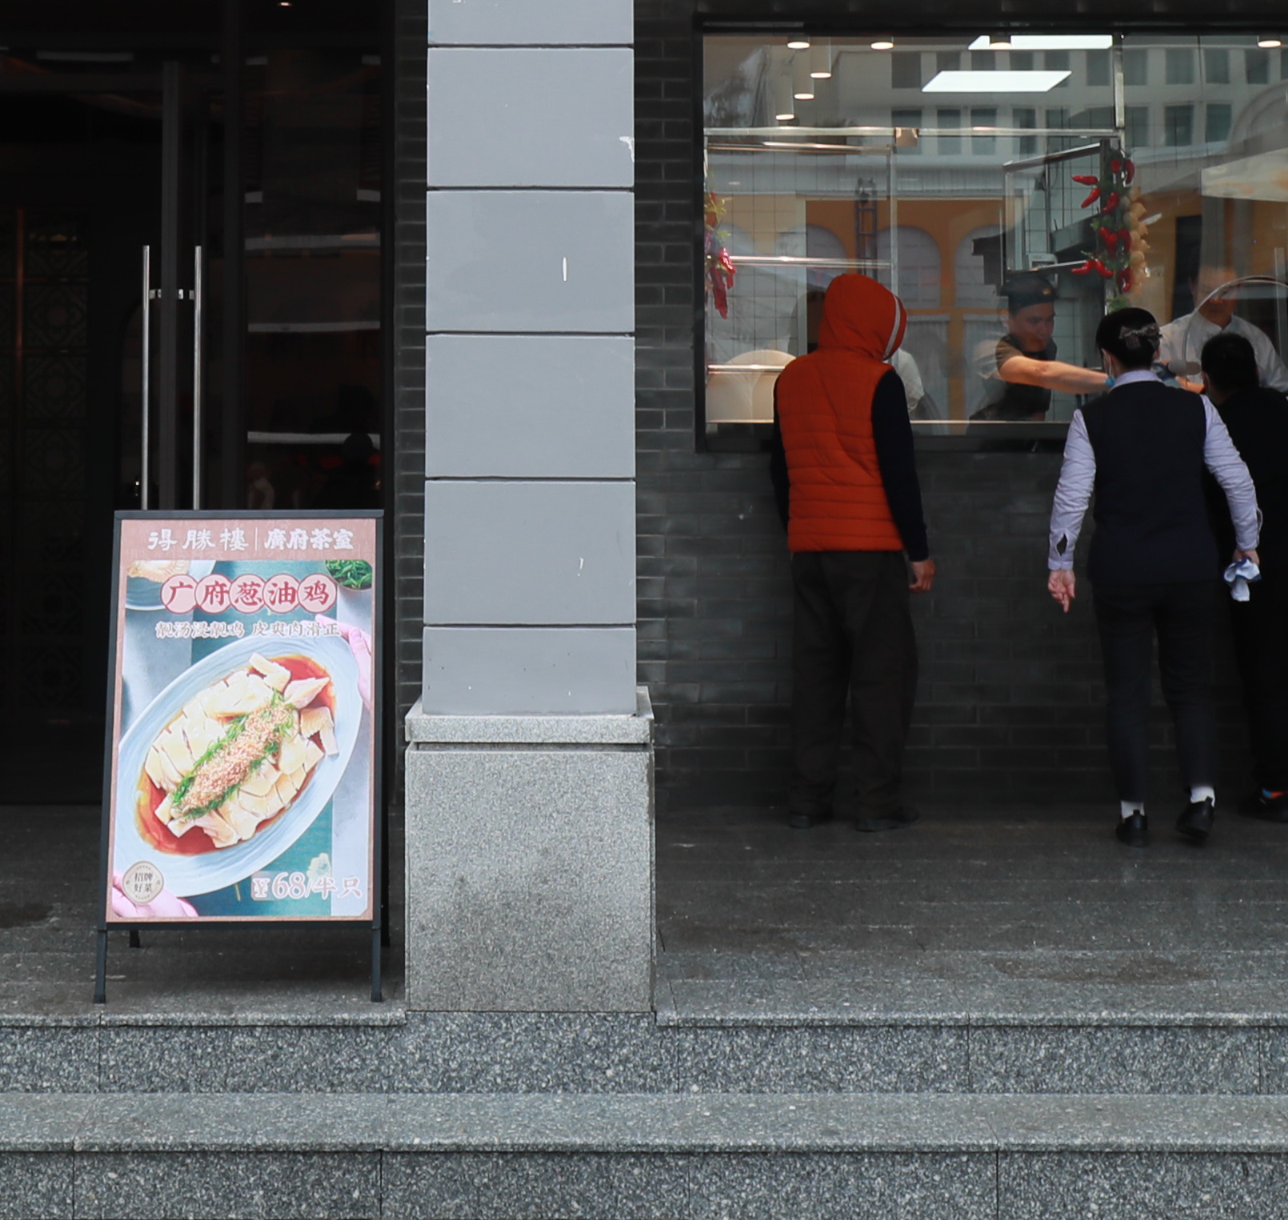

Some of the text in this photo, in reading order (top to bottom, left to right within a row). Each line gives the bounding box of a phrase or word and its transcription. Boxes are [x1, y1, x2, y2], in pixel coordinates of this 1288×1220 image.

[264, 528, 354, 551] 廣府茶室
[167, 580, 330, 606] 广府葱油鸡
